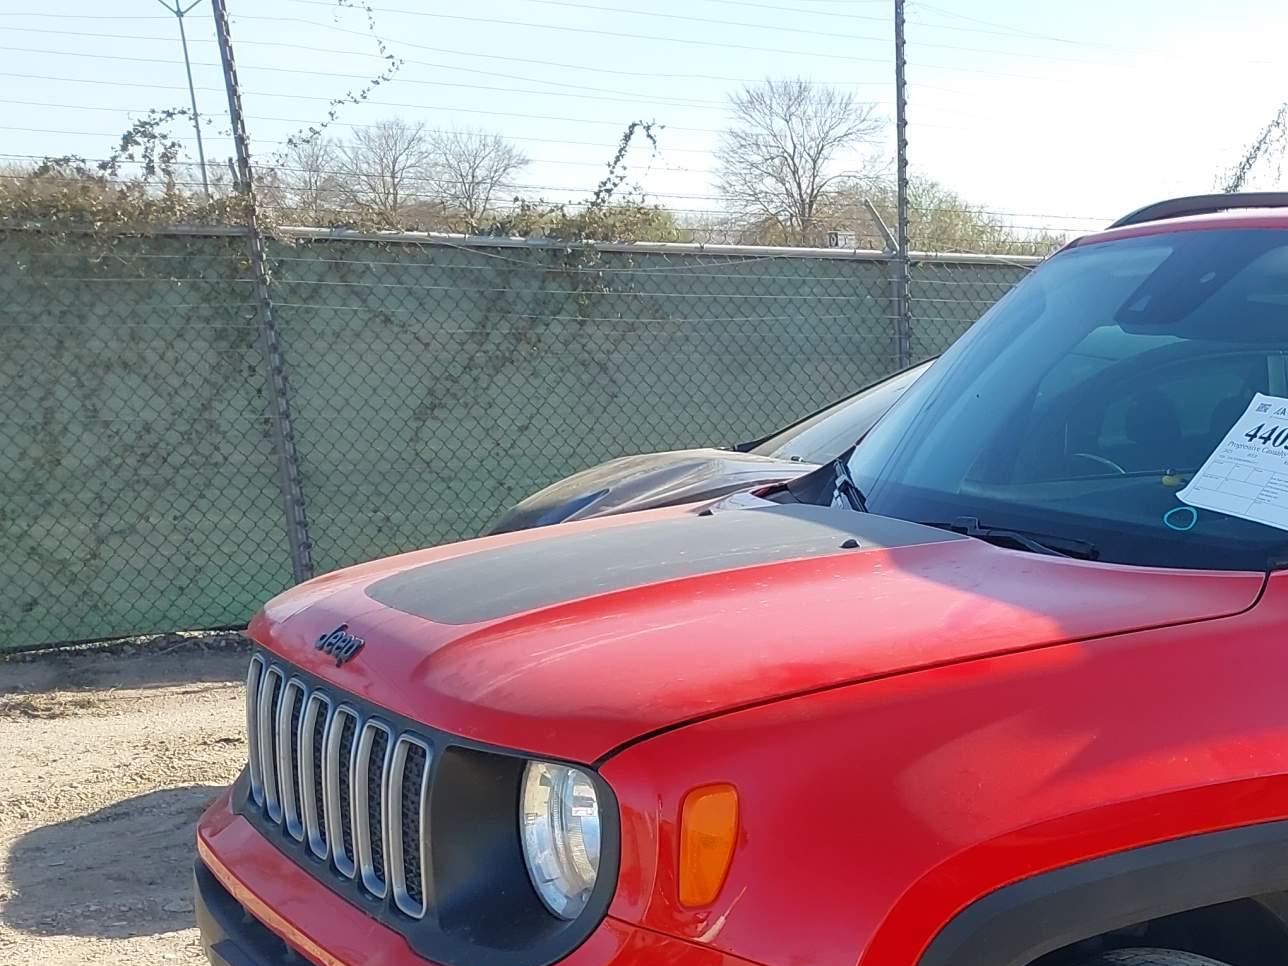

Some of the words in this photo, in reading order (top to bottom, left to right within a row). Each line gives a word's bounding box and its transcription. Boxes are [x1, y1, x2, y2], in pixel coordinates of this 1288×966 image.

[1227, 440, 1261, 454] Progressive
[1262, 447, 1287, 459] Casualty
[315, 622, 366, 669] Jeep
